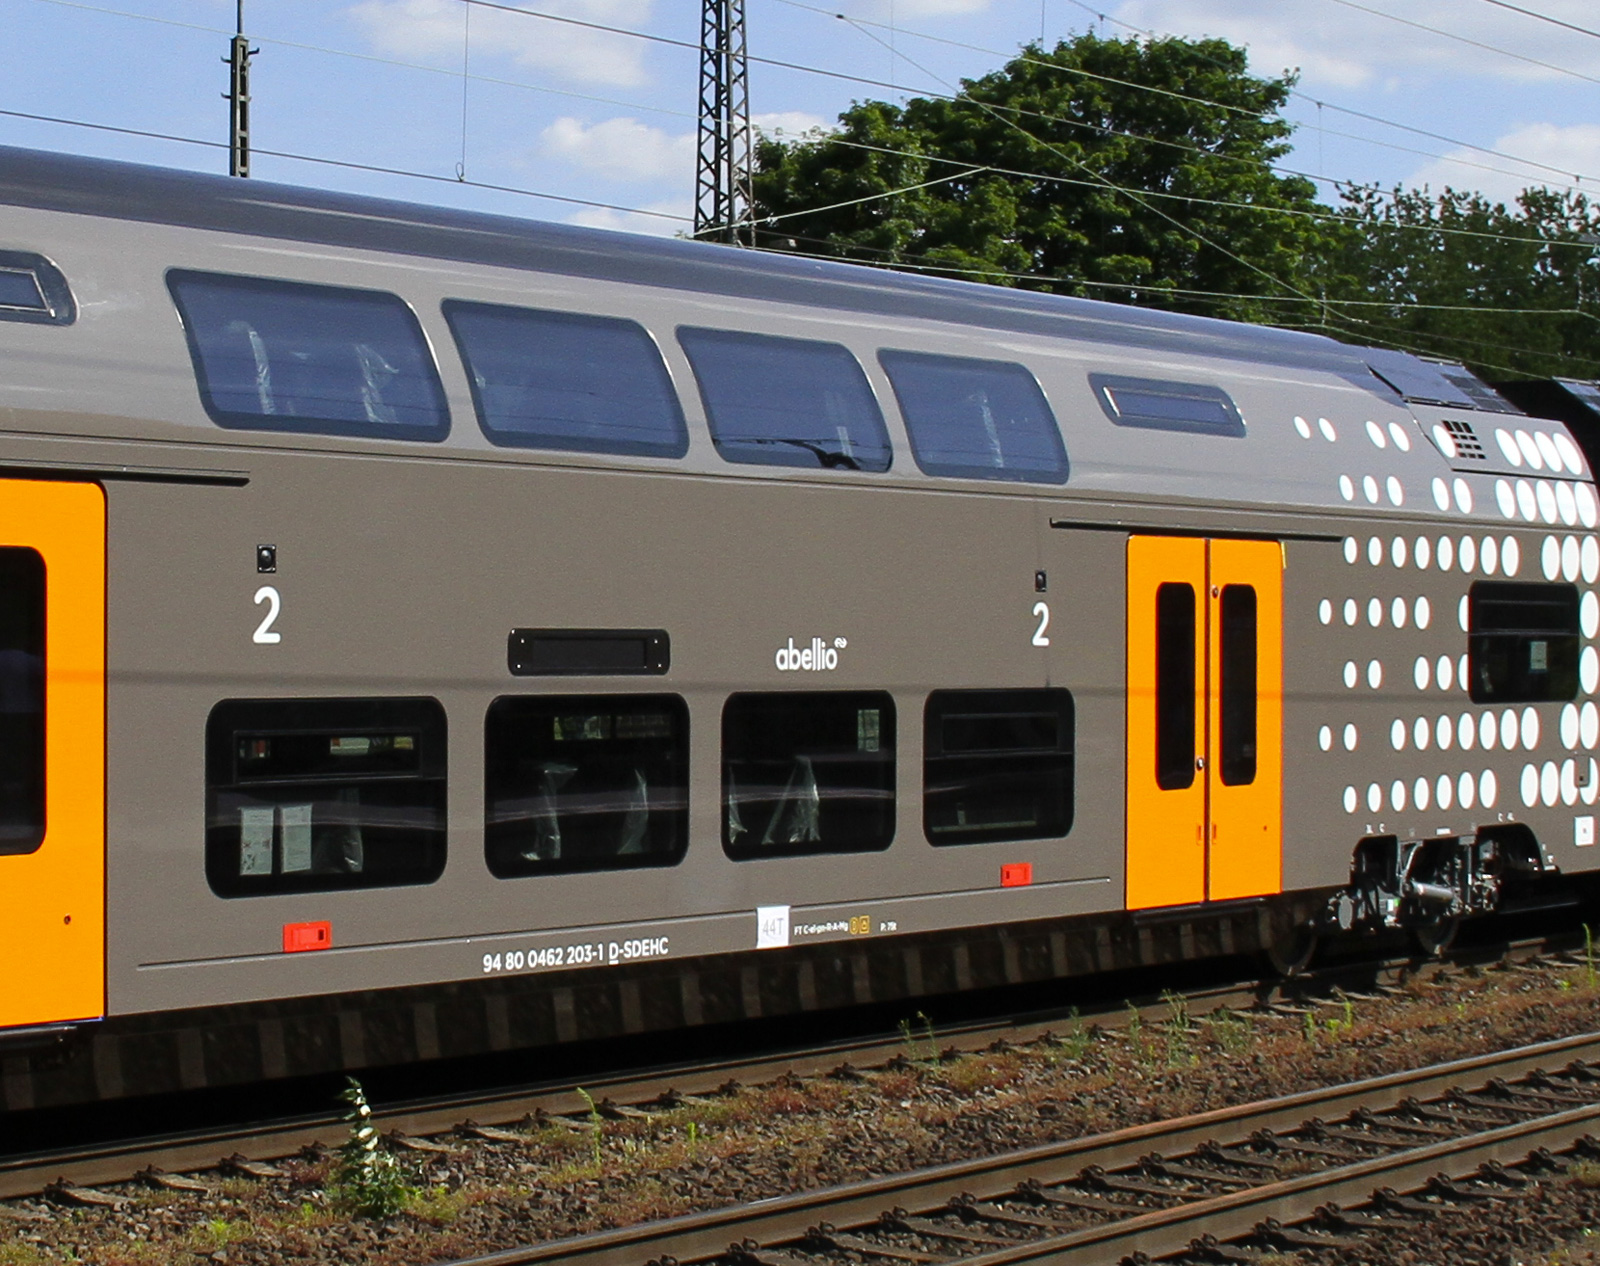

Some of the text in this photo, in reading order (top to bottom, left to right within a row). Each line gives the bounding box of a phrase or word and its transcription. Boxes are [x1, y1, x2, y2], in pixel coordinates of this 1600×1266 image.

[252, 586, 281, 645] 2
[1032, 602, 1050, 647] 2
[775, 637, 838, 671] abellio
[483, 937, 669, 973] 94 80 0462 203-1 D-SDEHC
